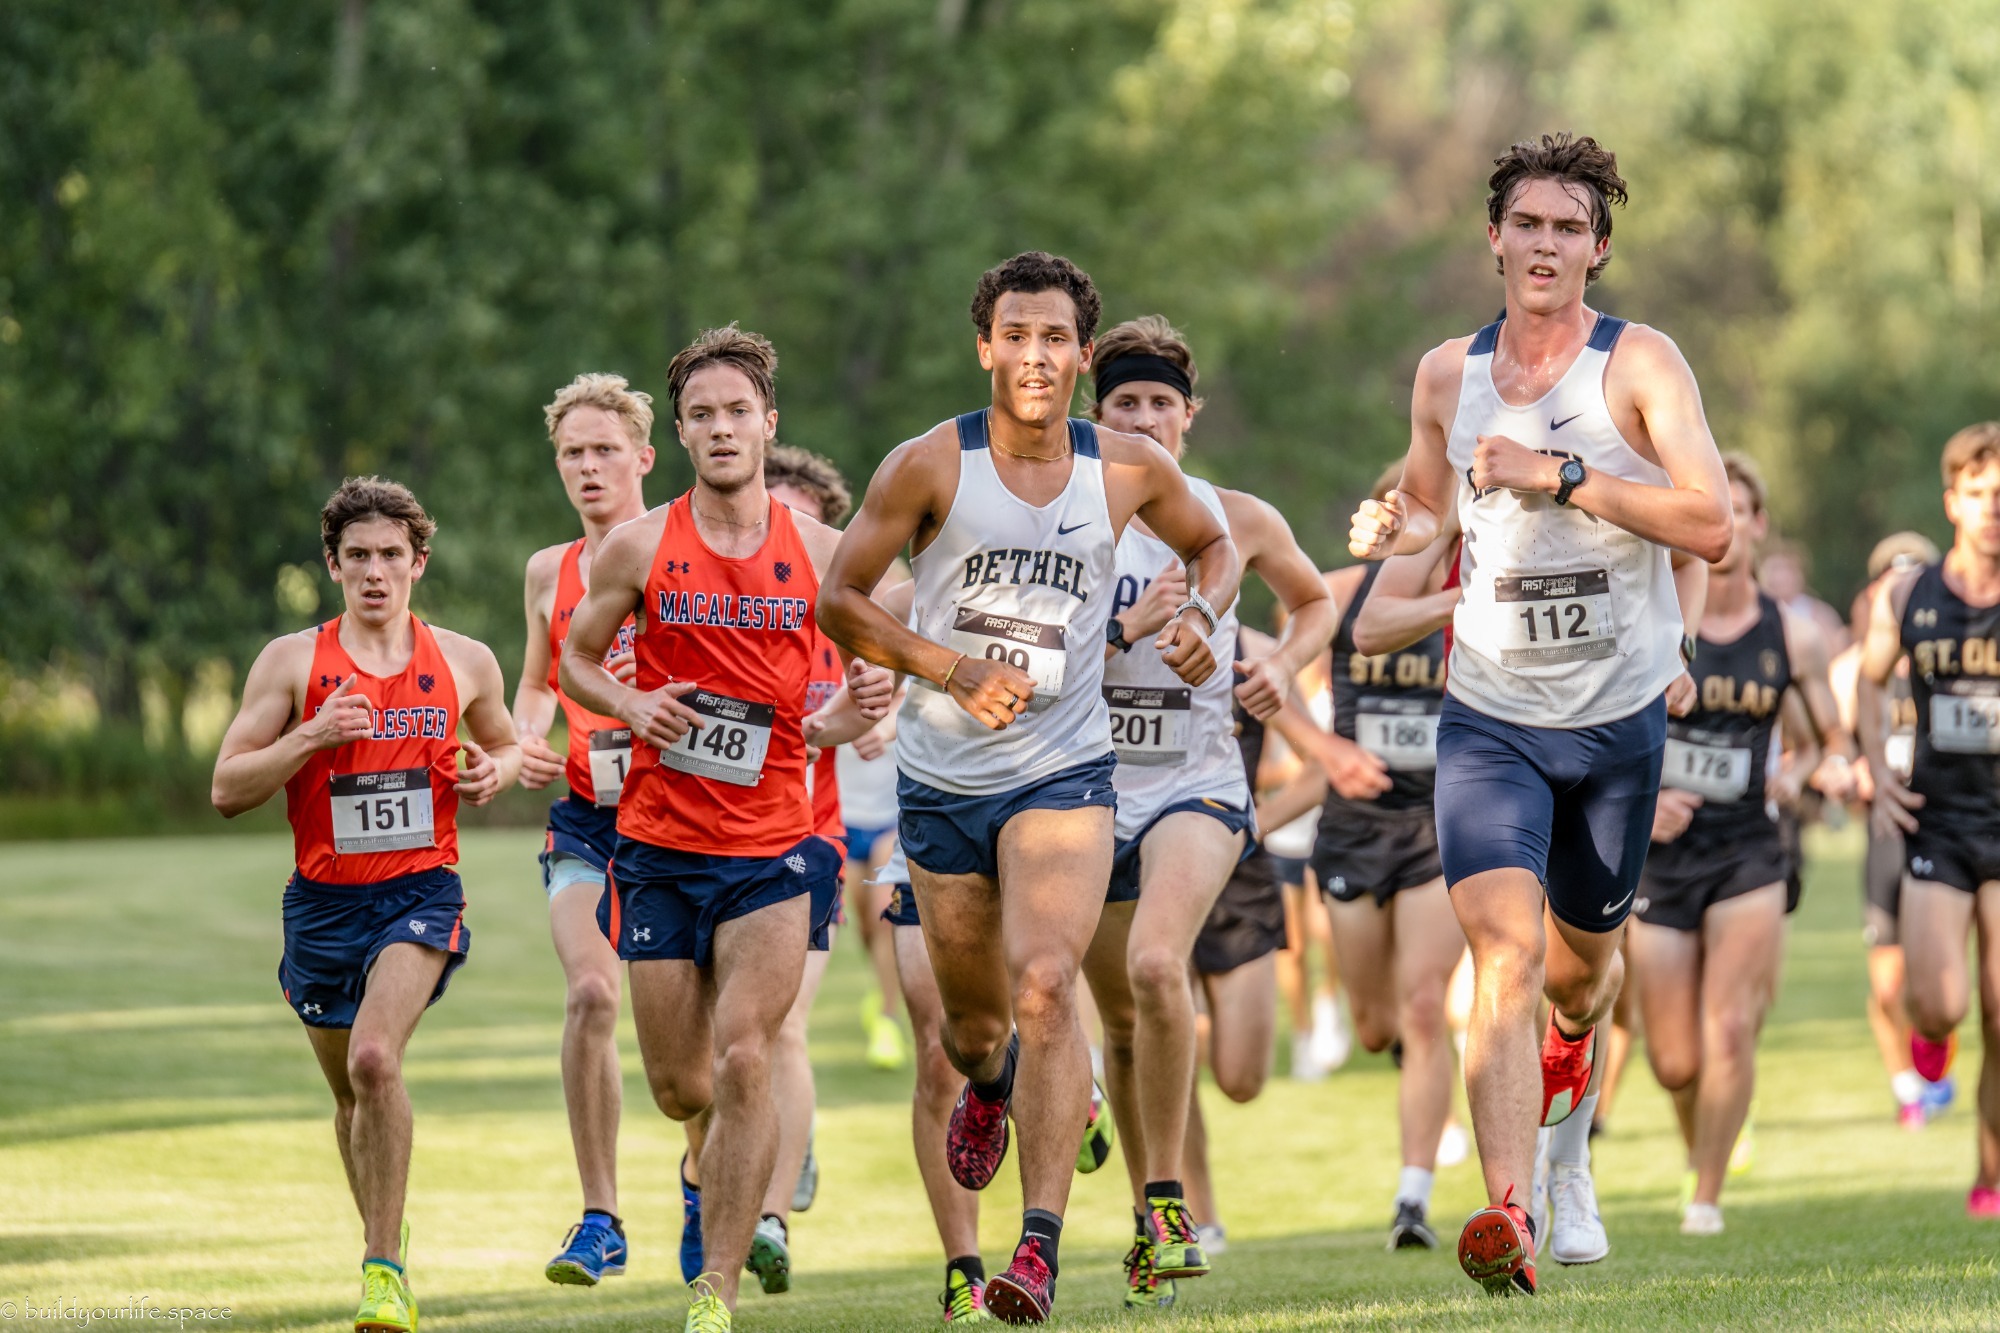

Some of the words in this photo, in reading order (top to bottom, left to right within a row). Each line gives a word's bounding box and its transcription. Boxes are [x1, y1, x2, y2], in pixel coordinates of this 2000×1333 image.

[962, 549, 1088, 603] BETHEL
[1521, 579, 1544, 591] FAST
[659, 591, 808, 631] MACALESTER
[985, 617, 1009, 629] FAST
[1520, 603, 1590, 641] 112
[1962, 637, 2000, 676] OL
[696, 693, 720, 707] FAST
[315, 706, 448, 740] LESTER
[1110, 713, 1162, 746] 201
[687, 721, 748, 761] 148
[356, 774, 378, 786] FAST
[354, 796, 410, 831] 151
